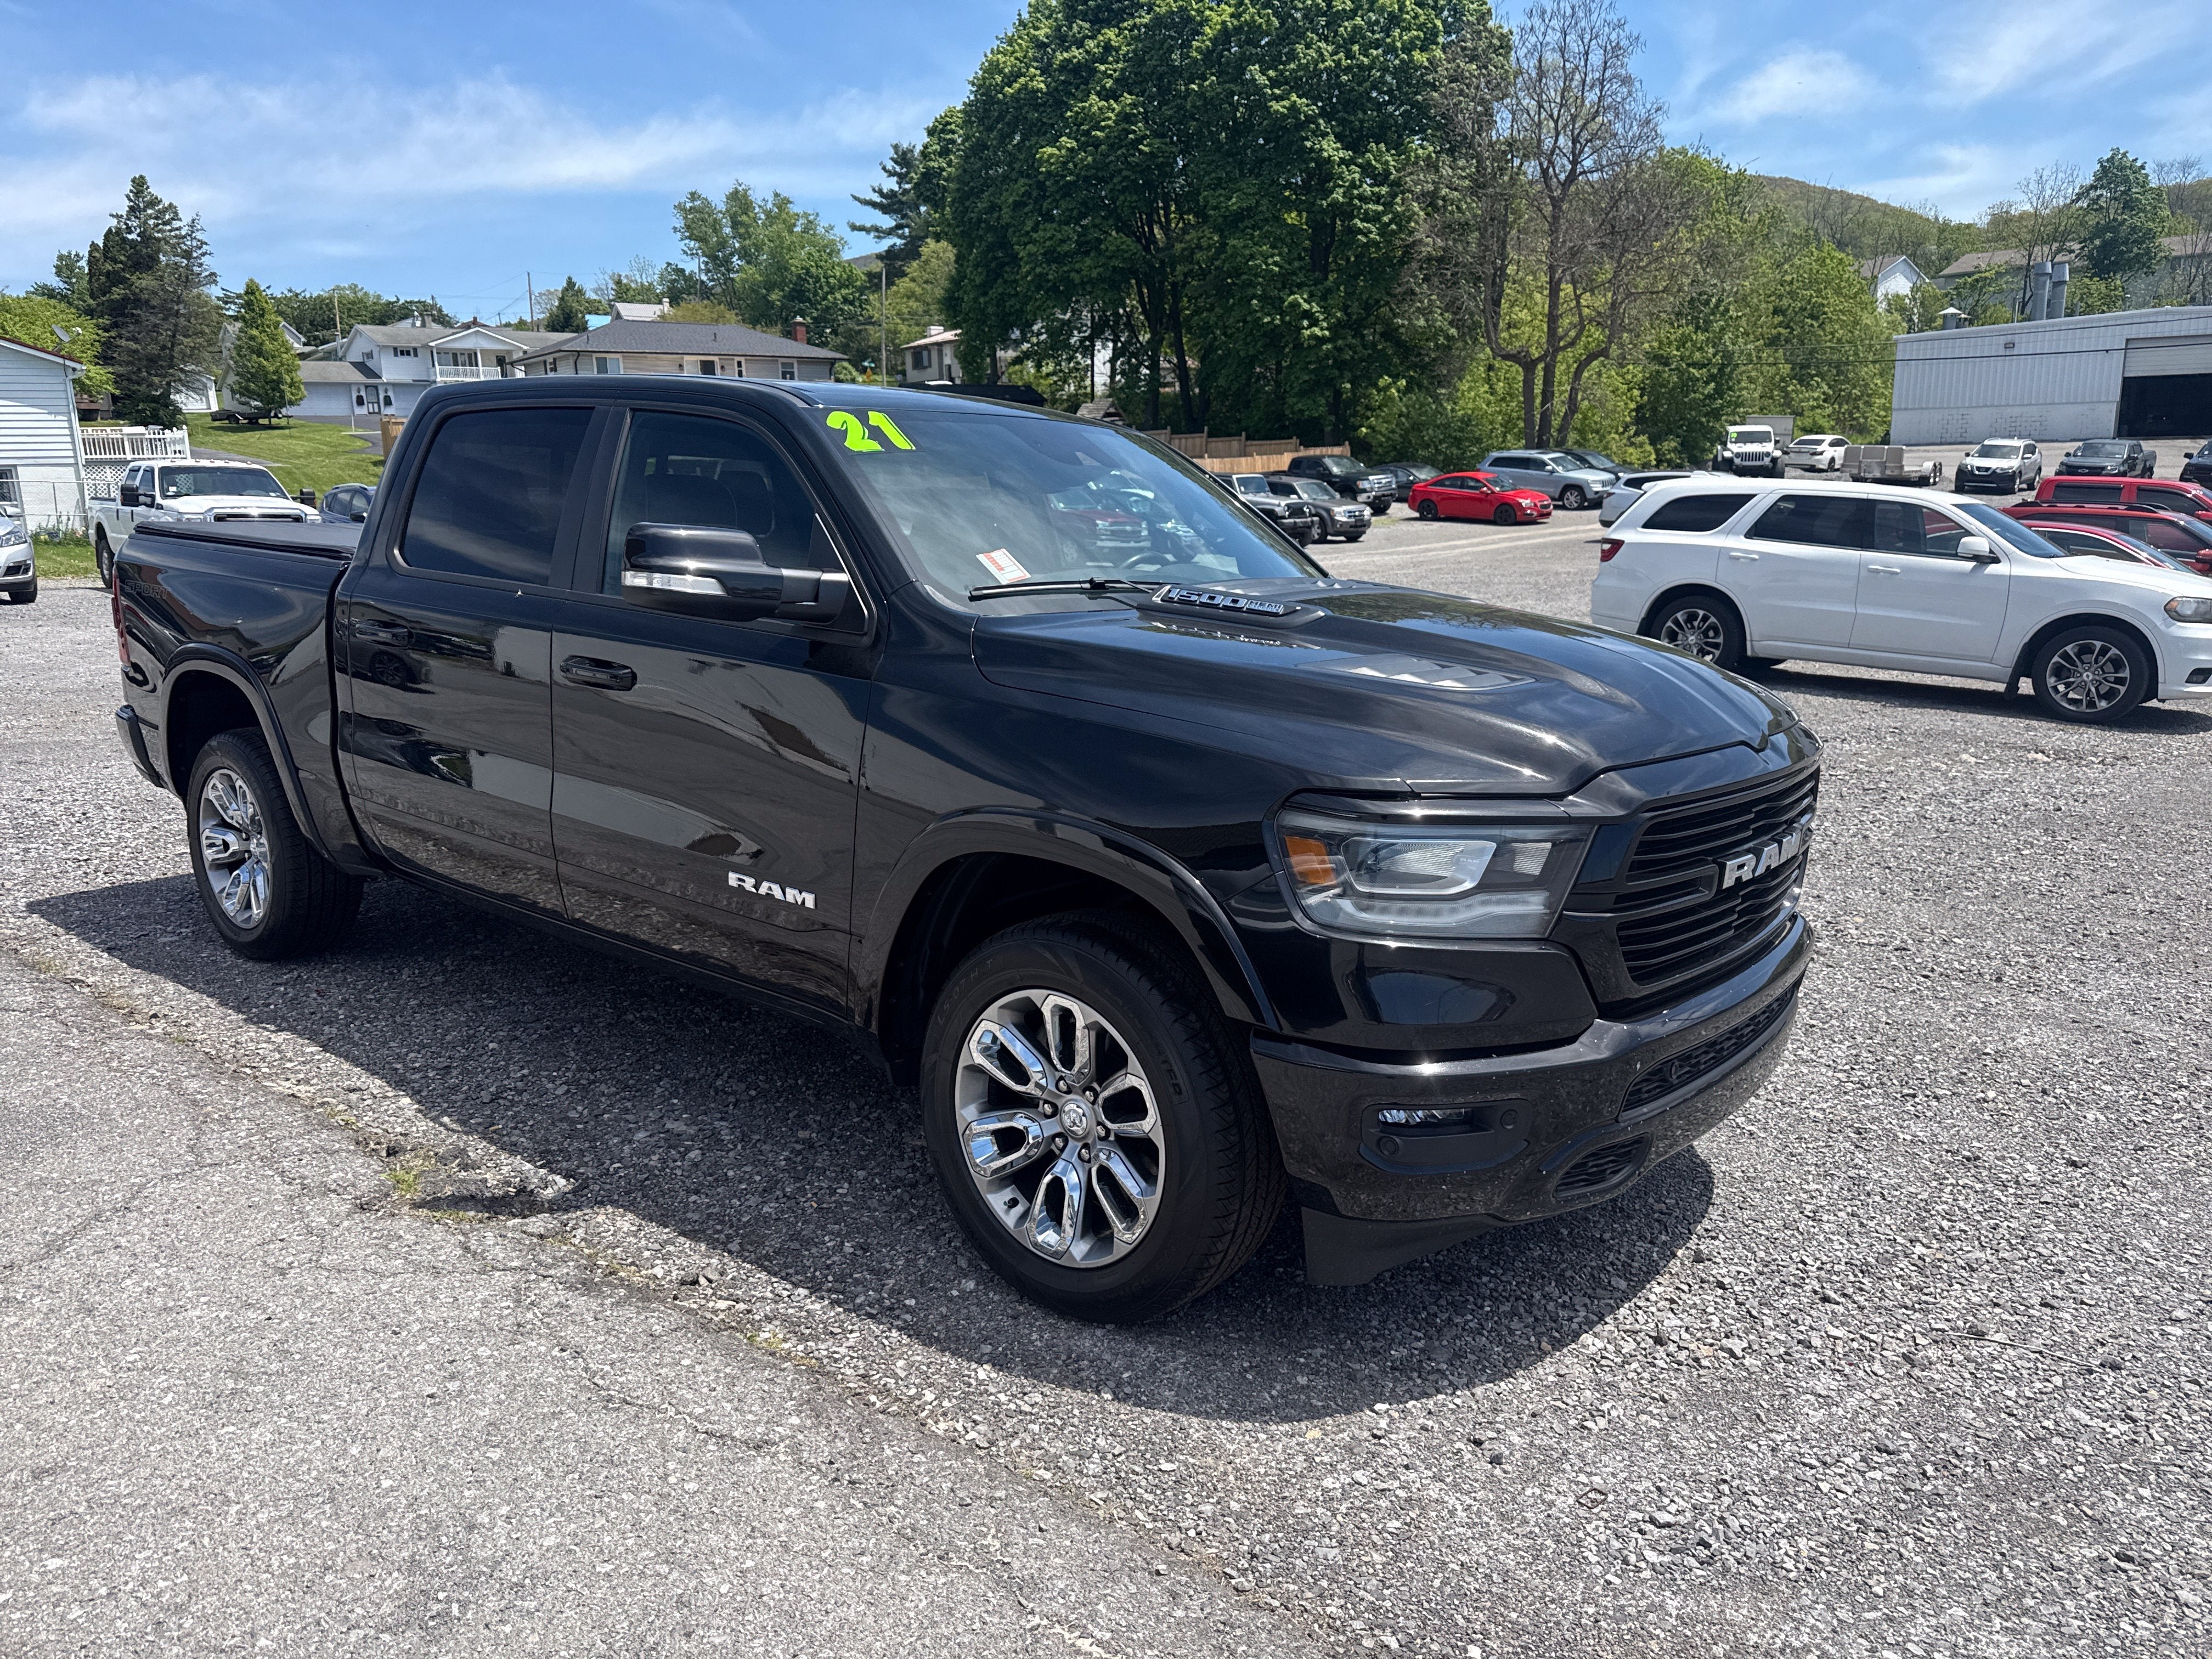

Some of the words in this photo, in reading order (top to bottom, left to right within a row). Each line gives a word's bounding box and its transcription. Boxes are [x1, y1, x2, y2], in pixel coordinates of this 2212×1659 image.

[826, 411, 916, 452] 21
[125, 579, 167, 599] SPORT
[1167, 588, 1248, 608] 1500
[1249, 601, 1282, 609] HEMI
[1720, 823, 1802, 890] RAM
[728, 871, 816, 910] RAM
